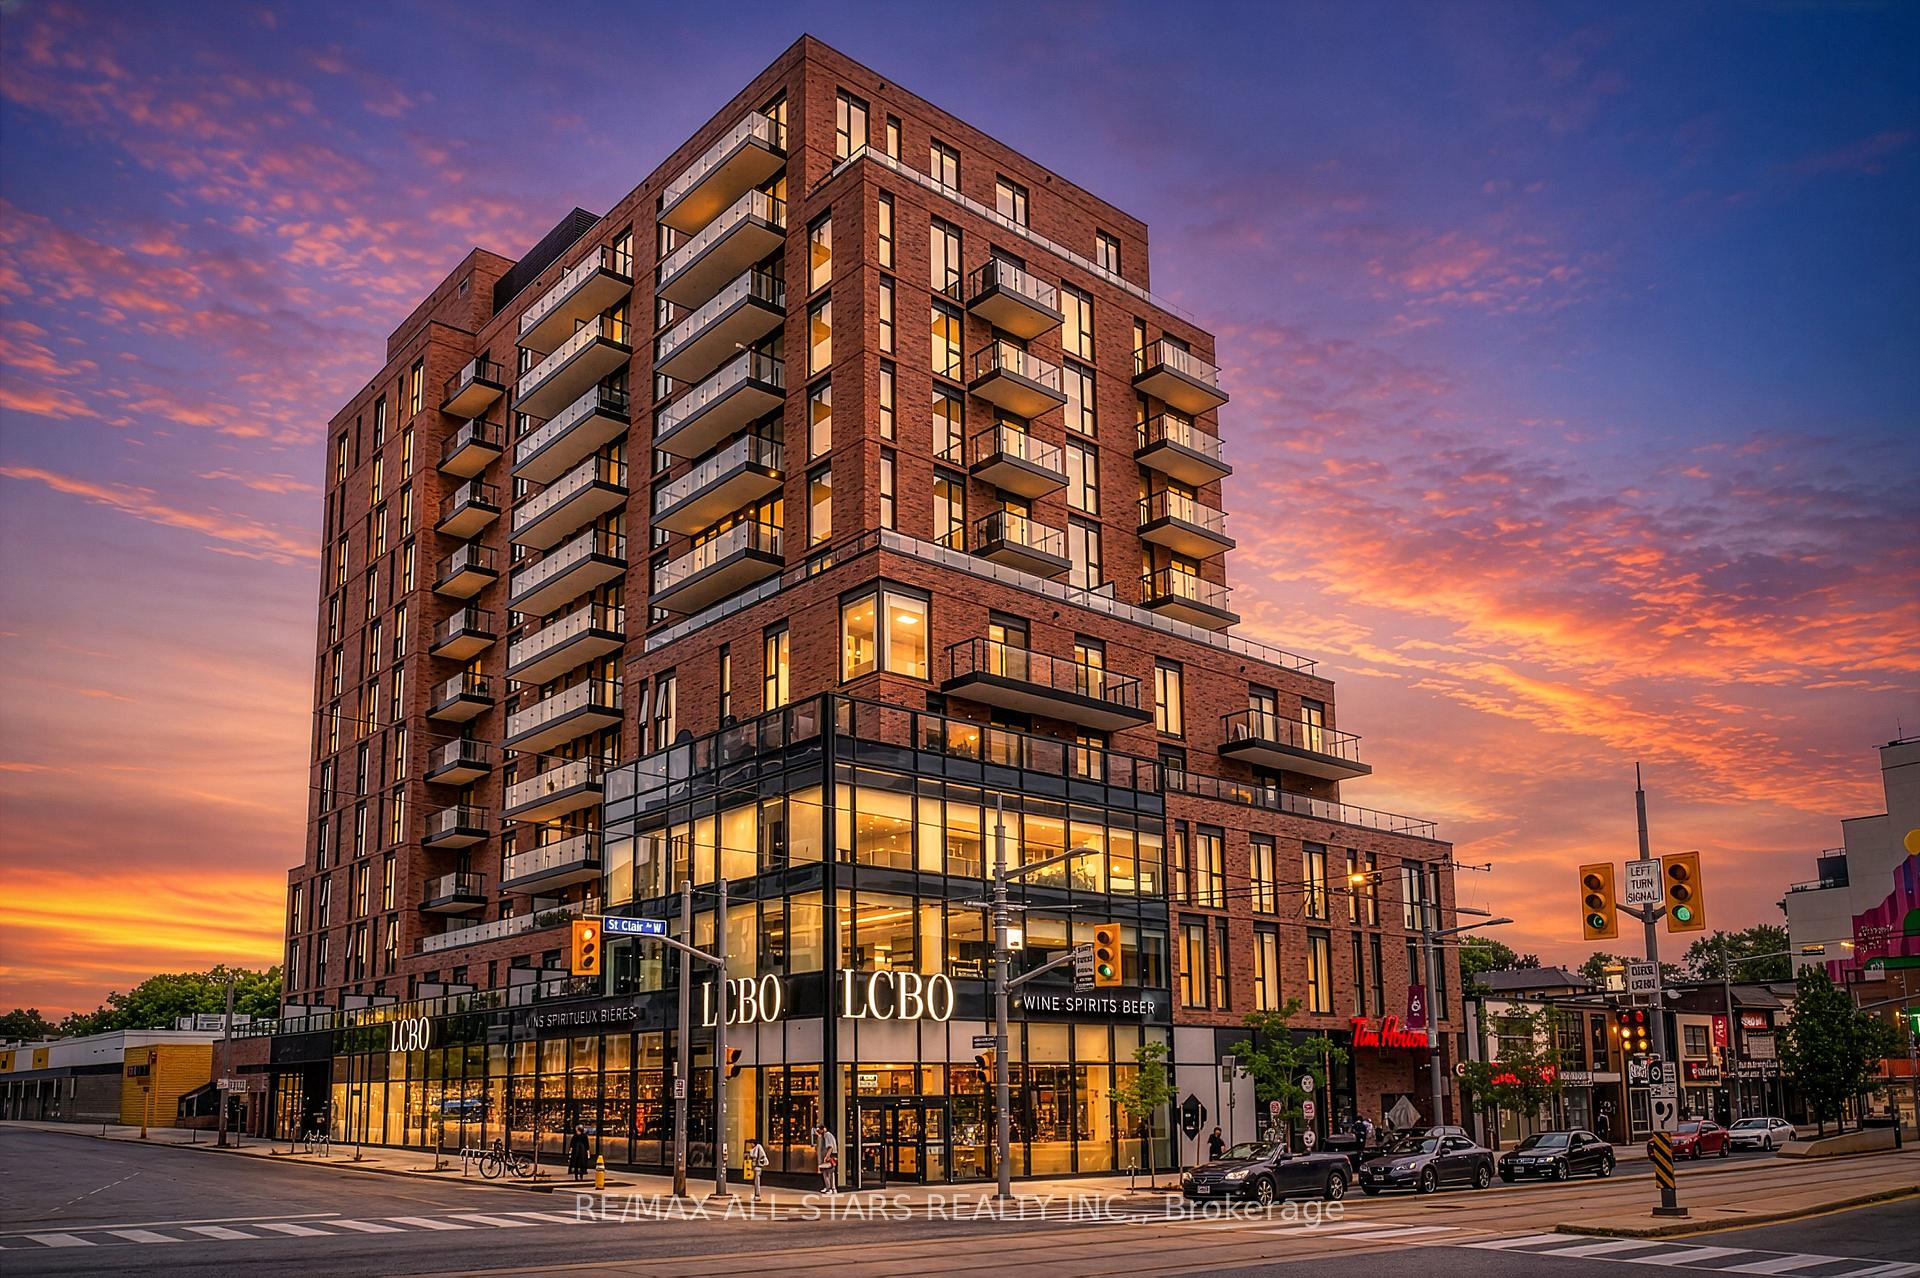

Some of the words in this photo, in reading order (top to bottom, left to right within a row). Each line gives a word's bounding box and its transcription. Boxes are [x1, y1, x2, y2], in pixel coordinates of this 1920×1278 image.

[1630, 866, 1651, 877] LEFT
[1631, 879, 1653, 890] TURN
[1627, 891, 1658, 903] SIGNAL
[608, 919, 619, 930] St
[621, 920, 643, 932] Clair
[653, 923, 662, 933] W
[702, 973, 781, 1027] LCBO
[842, 968, 954, 1022] LCBO
[1023, 995, 1060, 1011] WINE
[1065, 997, 1117, 1013] SPIRITS
[1122, 1000, 1155, 1014] BEER
[525, 1015, 544, 1028] VINS
[546, 1010, 598, 1027] SPIRITUEUX
[600, 1006, 634, 1022] BIÈRES
[391, 1016, 430, 1052] LCBO
[1350, 1016, 1379, 1048] Tim
[1381, 1014, 1429, 1048] Horton
